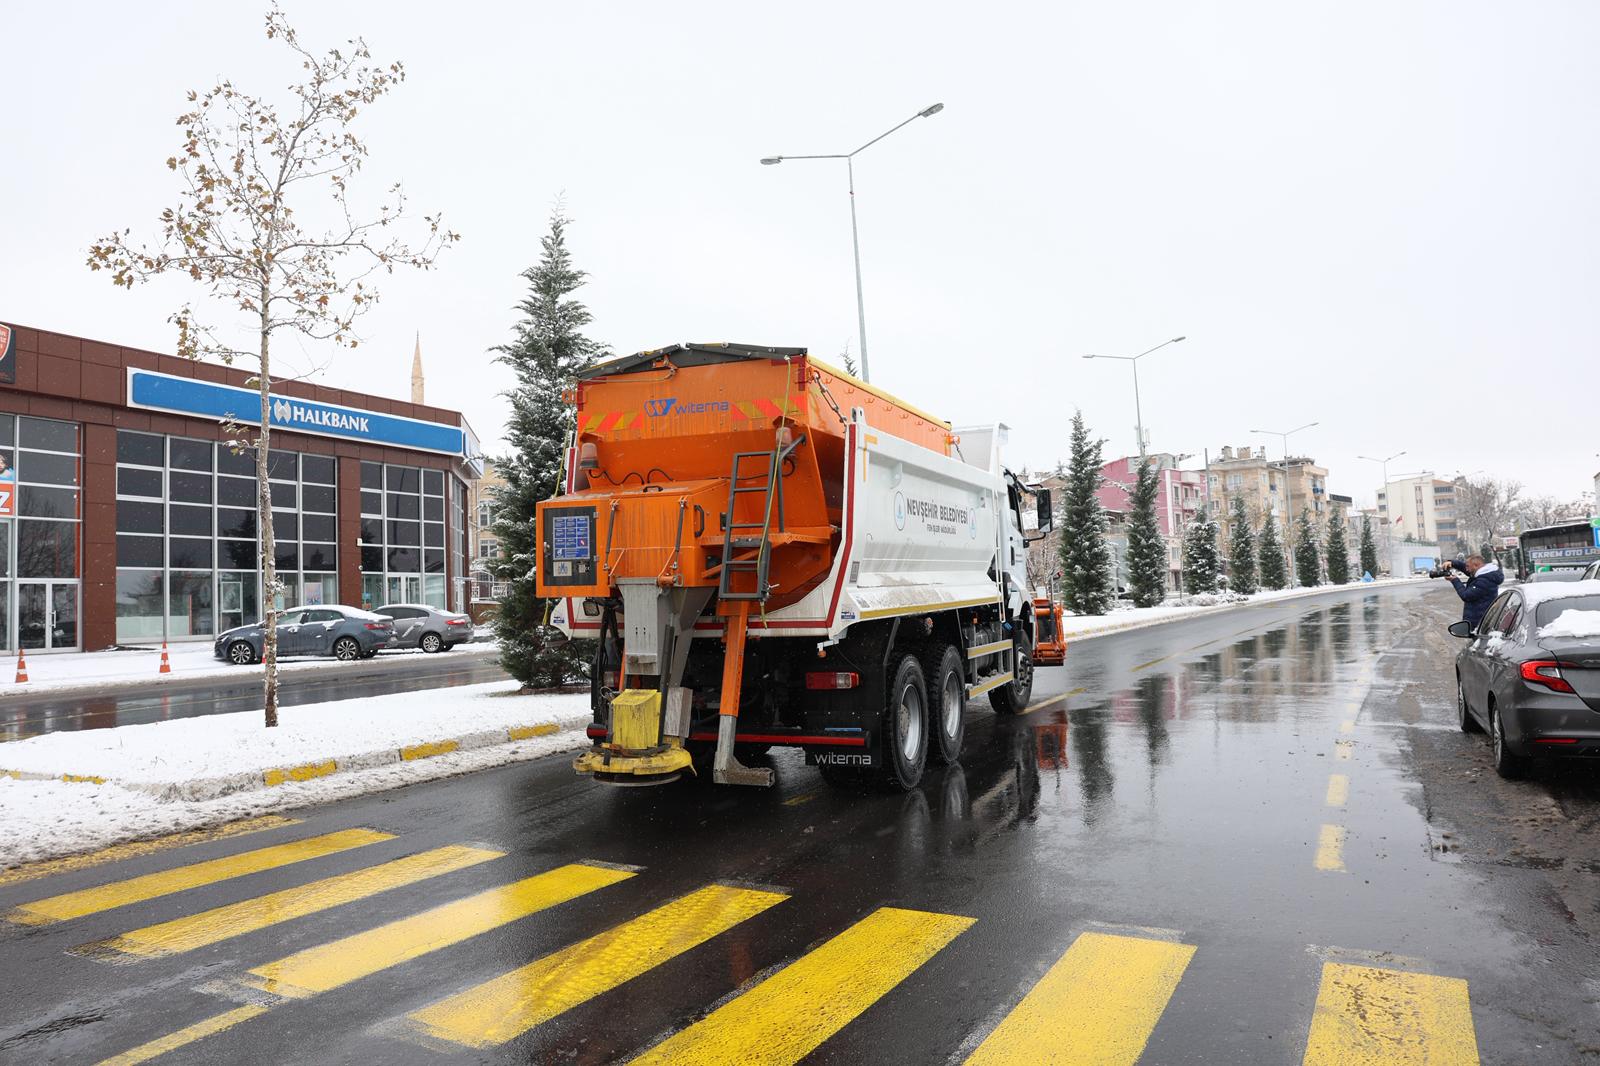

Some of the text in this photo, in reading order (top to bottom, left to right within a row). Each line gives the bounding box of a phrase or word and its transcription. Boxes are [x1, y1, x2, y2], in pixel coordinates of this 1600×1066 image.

[675, 401, 729, 415] witerna
[293, 405, 369, 432] HALKBANK
[906, 498, 969, 525] NEVŞEHİR BELEDİYESİ
[1531, 550, 1563, 559] EKREM
[814, 751, 872, 765] witerna
